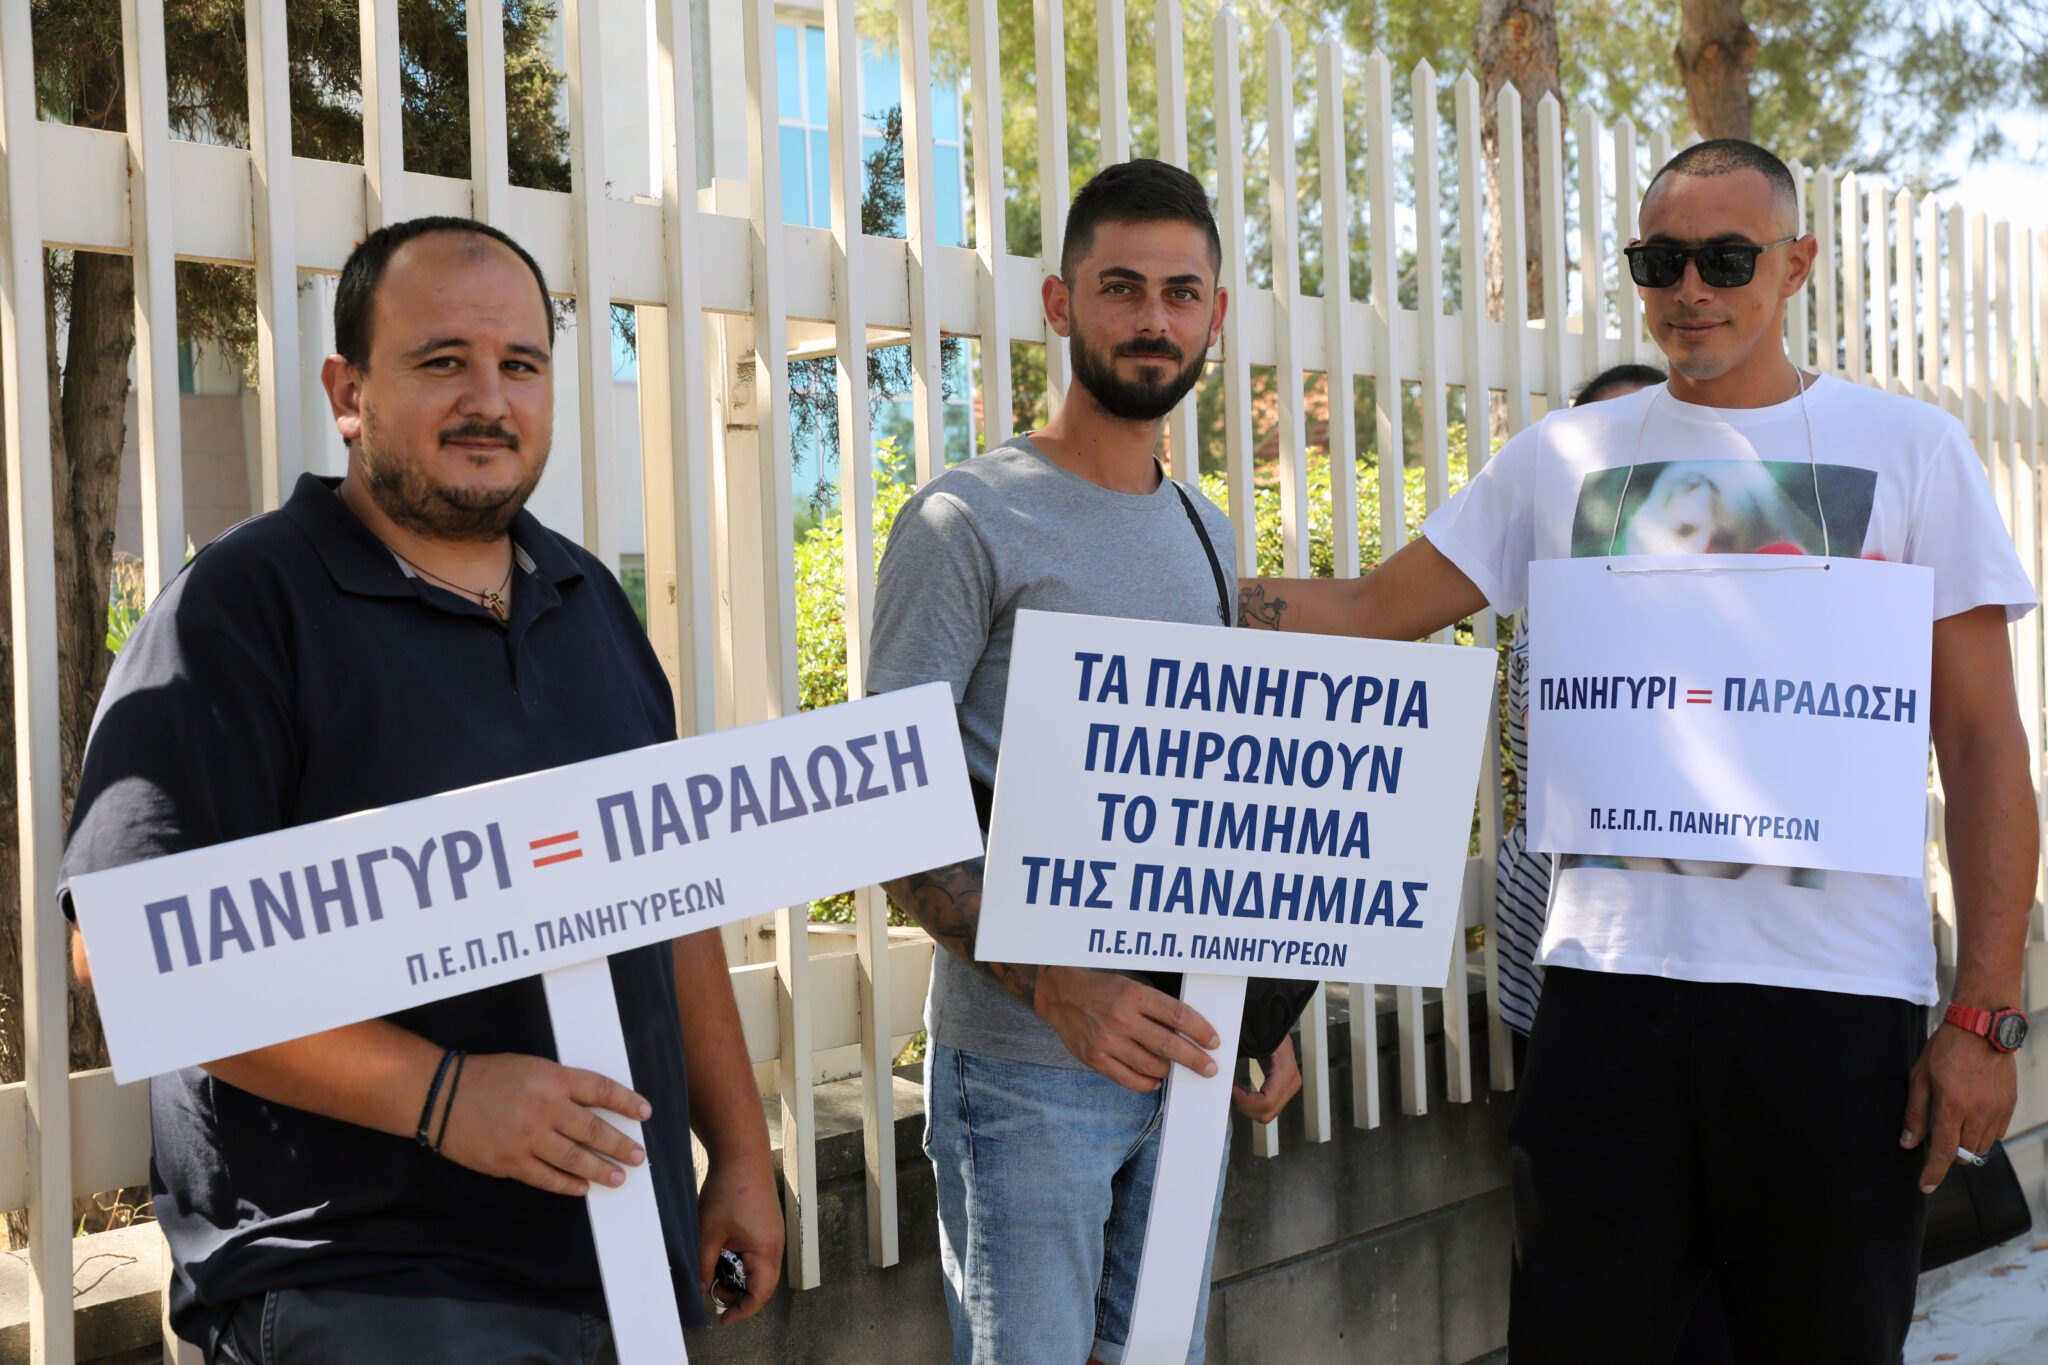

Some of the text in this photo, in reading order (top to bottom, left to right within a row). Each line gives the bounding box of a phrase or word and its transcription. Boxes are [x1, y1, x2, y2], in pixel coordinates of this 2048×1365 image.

[1074, 651, 1430, 729] ΤΑ ΠΑΝΗΓΥΡΙΑ
[1540, 675, 1677, 711] ΠΑΝΗΓΥΡΙ
[1723, 677, 1917, 723] ΠΑΡΑΔΩΣΗ
[1084, 722, 1404, 794] ΠΛΗΡΩΝΟΥΝ
[143, 821, 512, 975] ΠΑΝΗΓΥΡΙ
[596, 723, 930, 863] ΠΑΡΑΔΩΣΗ
[1097, 792, 1371, 860] ΤΟ ΤΙΜΗΜΑ
[1590, 807, 1821, 842] Π.Ε.Π.Π. ΠΑΝΗΓΥΡΕΩΝ
[1021, 855, 1429, 929] ΤΗΣ ΠΑΝΔΗΜΙΑΣ
[406, 876, 727, 987] Π.Ε.Π.Π. ΠΑΝΗΓΥΡΕΩΝ
[1087, 928, 1349, 968] Π.Ε.Π.Π. ΠΑΝΗΓΥΡΕΩΝ
